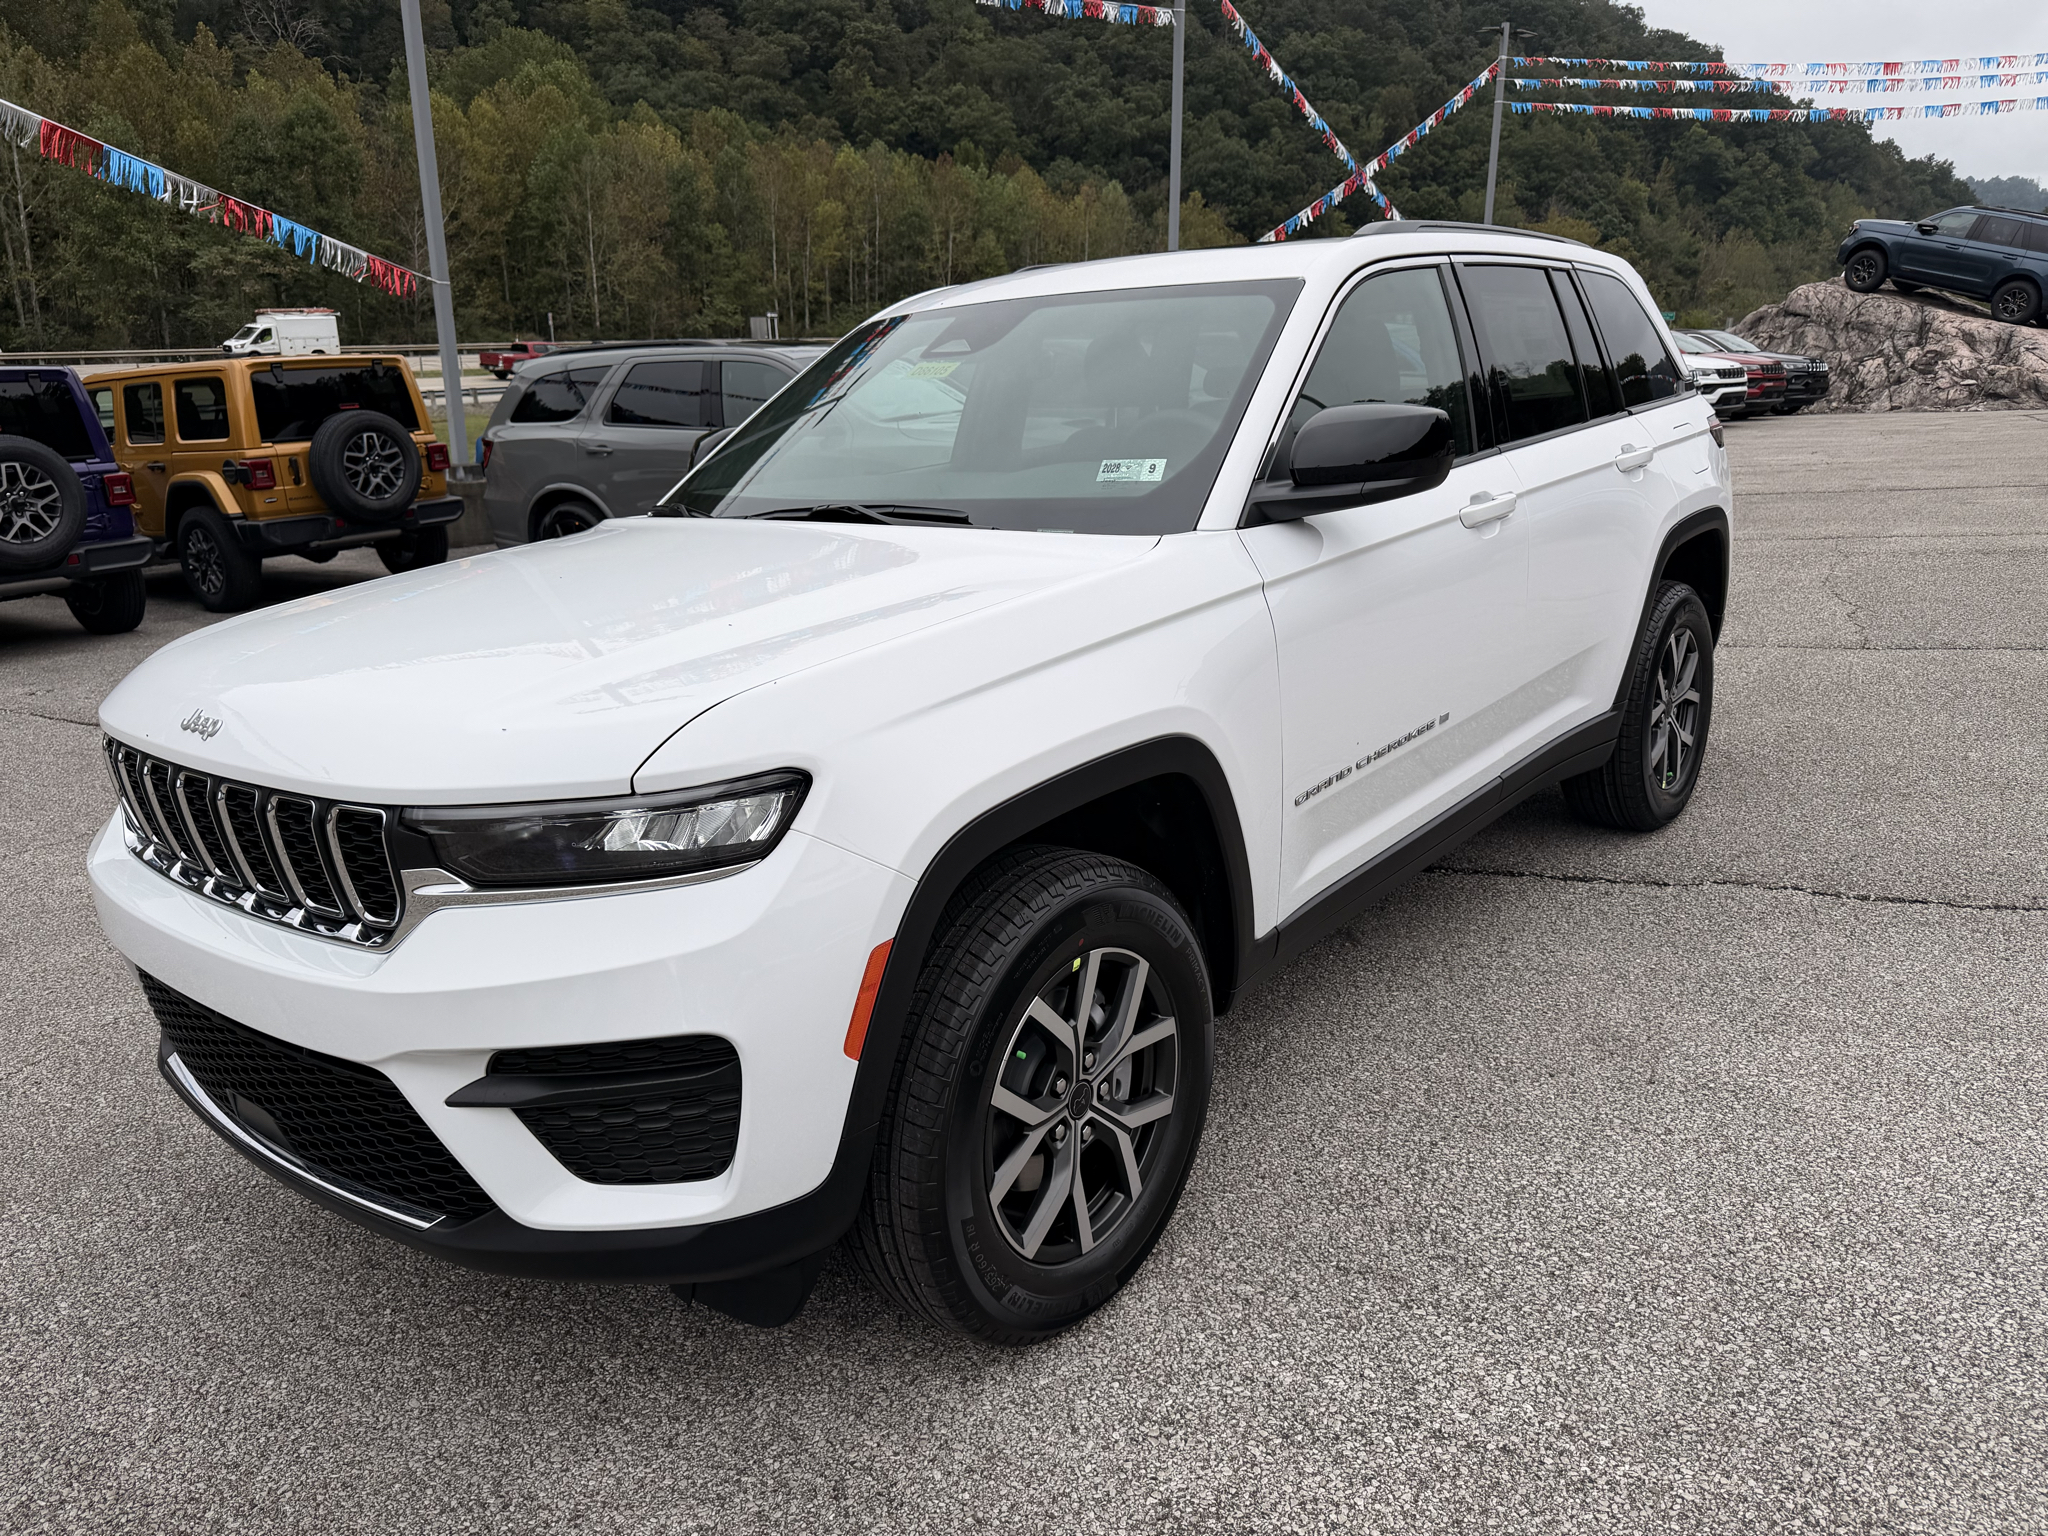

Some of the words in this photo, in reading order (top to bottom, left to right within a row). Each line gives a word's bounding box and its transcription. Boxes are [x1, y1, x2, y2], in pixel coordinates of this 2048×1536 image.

[1102, 463, 1121, 473] 2028
[1148, 463, 1157, 474] 9
[180, 708, 224, 741] Jeep
[1295, 765, 1353, 807] GRAND
[1356, 718, 1437, 770] CHEROKEE
[1118, 903, 1182, 944] MICHELIN
[1185, 947, 1206, 994] PRIMACY
[965, 1223, 977, 1238] 18
